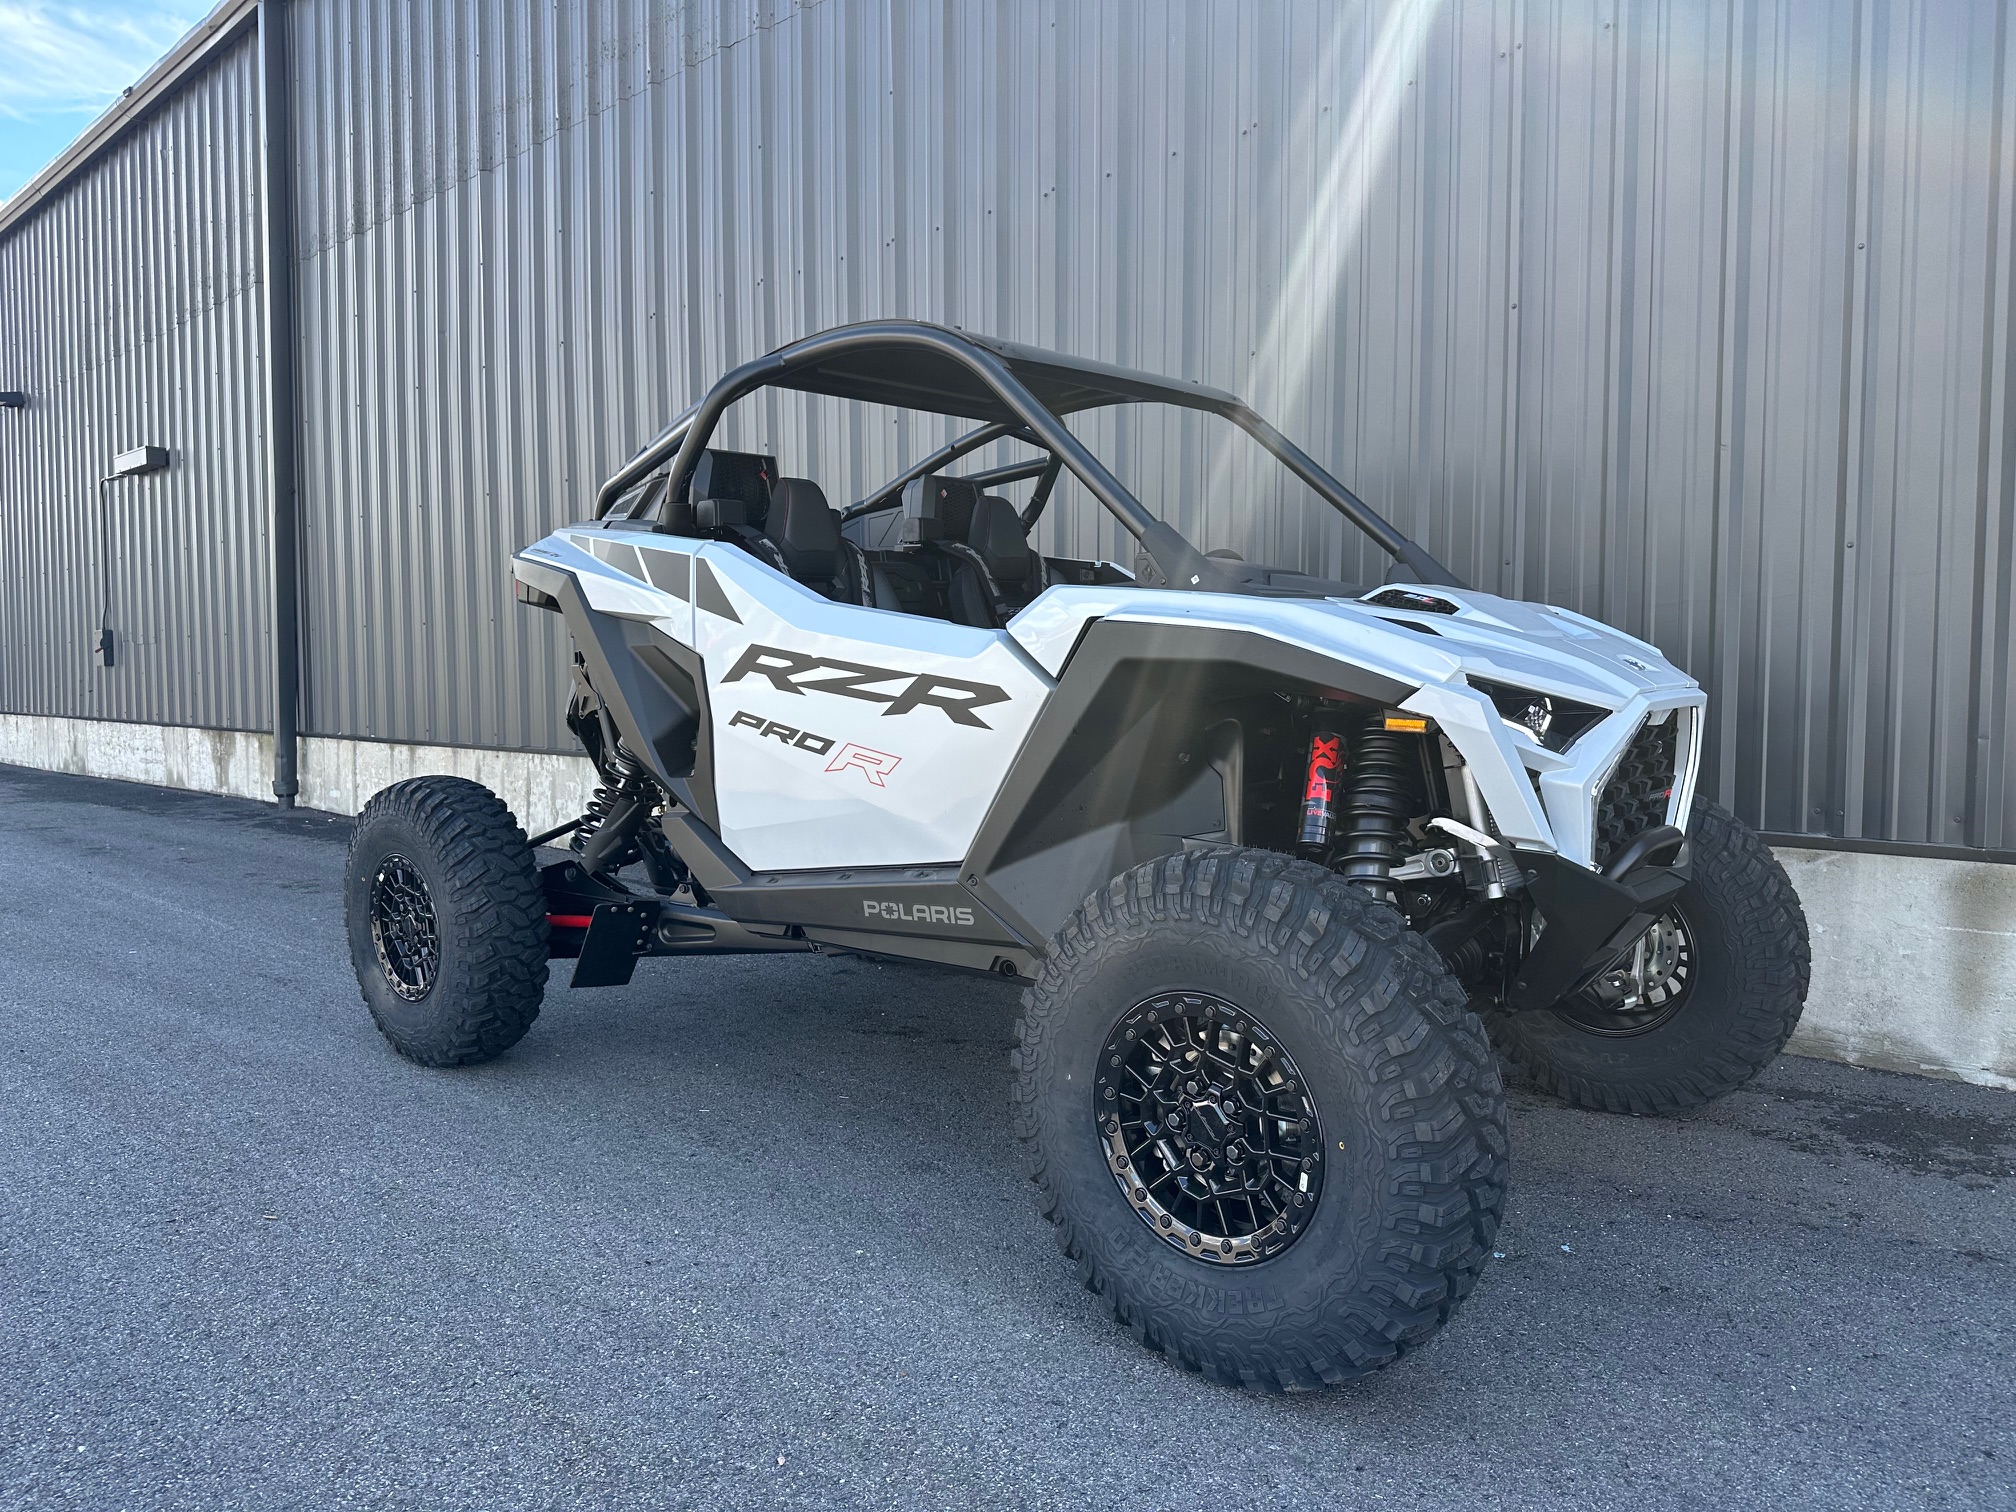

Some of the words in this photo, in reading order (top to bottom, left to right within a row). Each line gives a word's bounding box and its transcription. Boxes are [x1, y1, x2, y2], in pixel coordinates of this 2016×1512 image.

[720, 643, 1013, 731] RZR
[728, 710, 836, 756] PRO
[824, 742, 903, 788] R
[1305, 736, 1341, 802] FOX
[862, 900, 975, 926] POLARIS
[1108, 1226, 1149, 1273] 2.0
[1150, 1262, 1285, 1315] TREKKER
